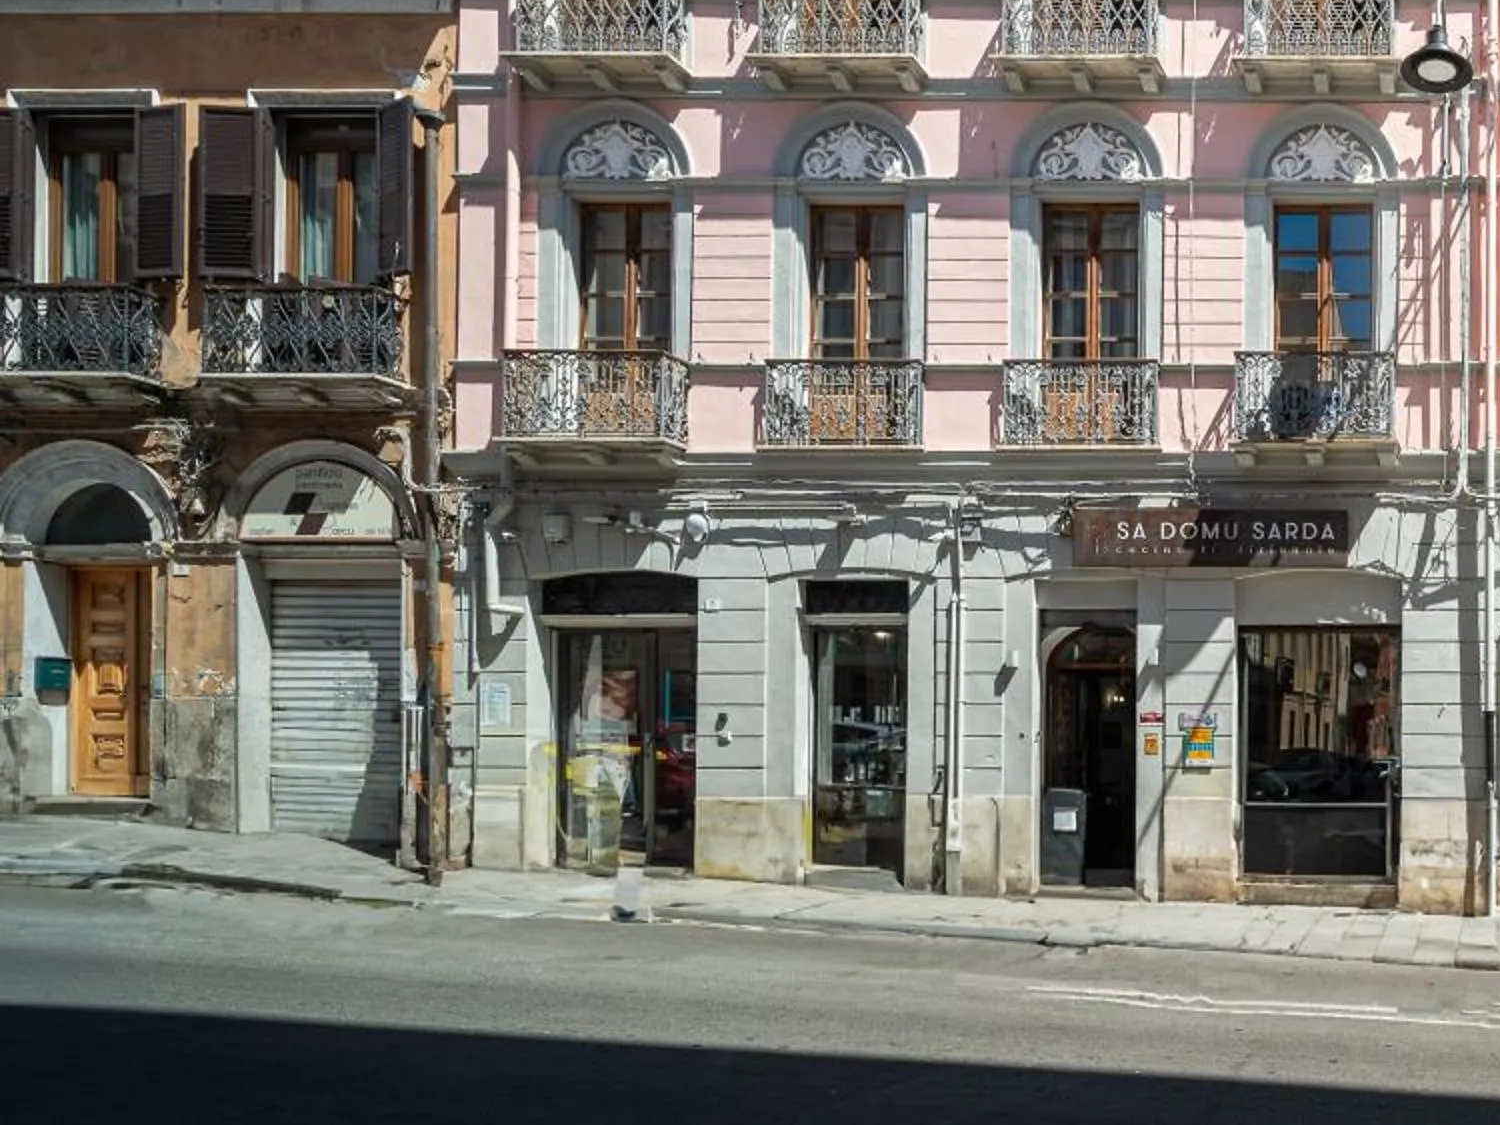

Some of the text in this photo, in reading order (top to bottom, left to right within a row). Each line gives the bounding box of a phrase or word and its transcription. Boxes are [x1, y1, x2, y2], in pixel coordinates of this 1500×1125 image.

[1117, 521, 1335, 540] SA DOMU SARDA
